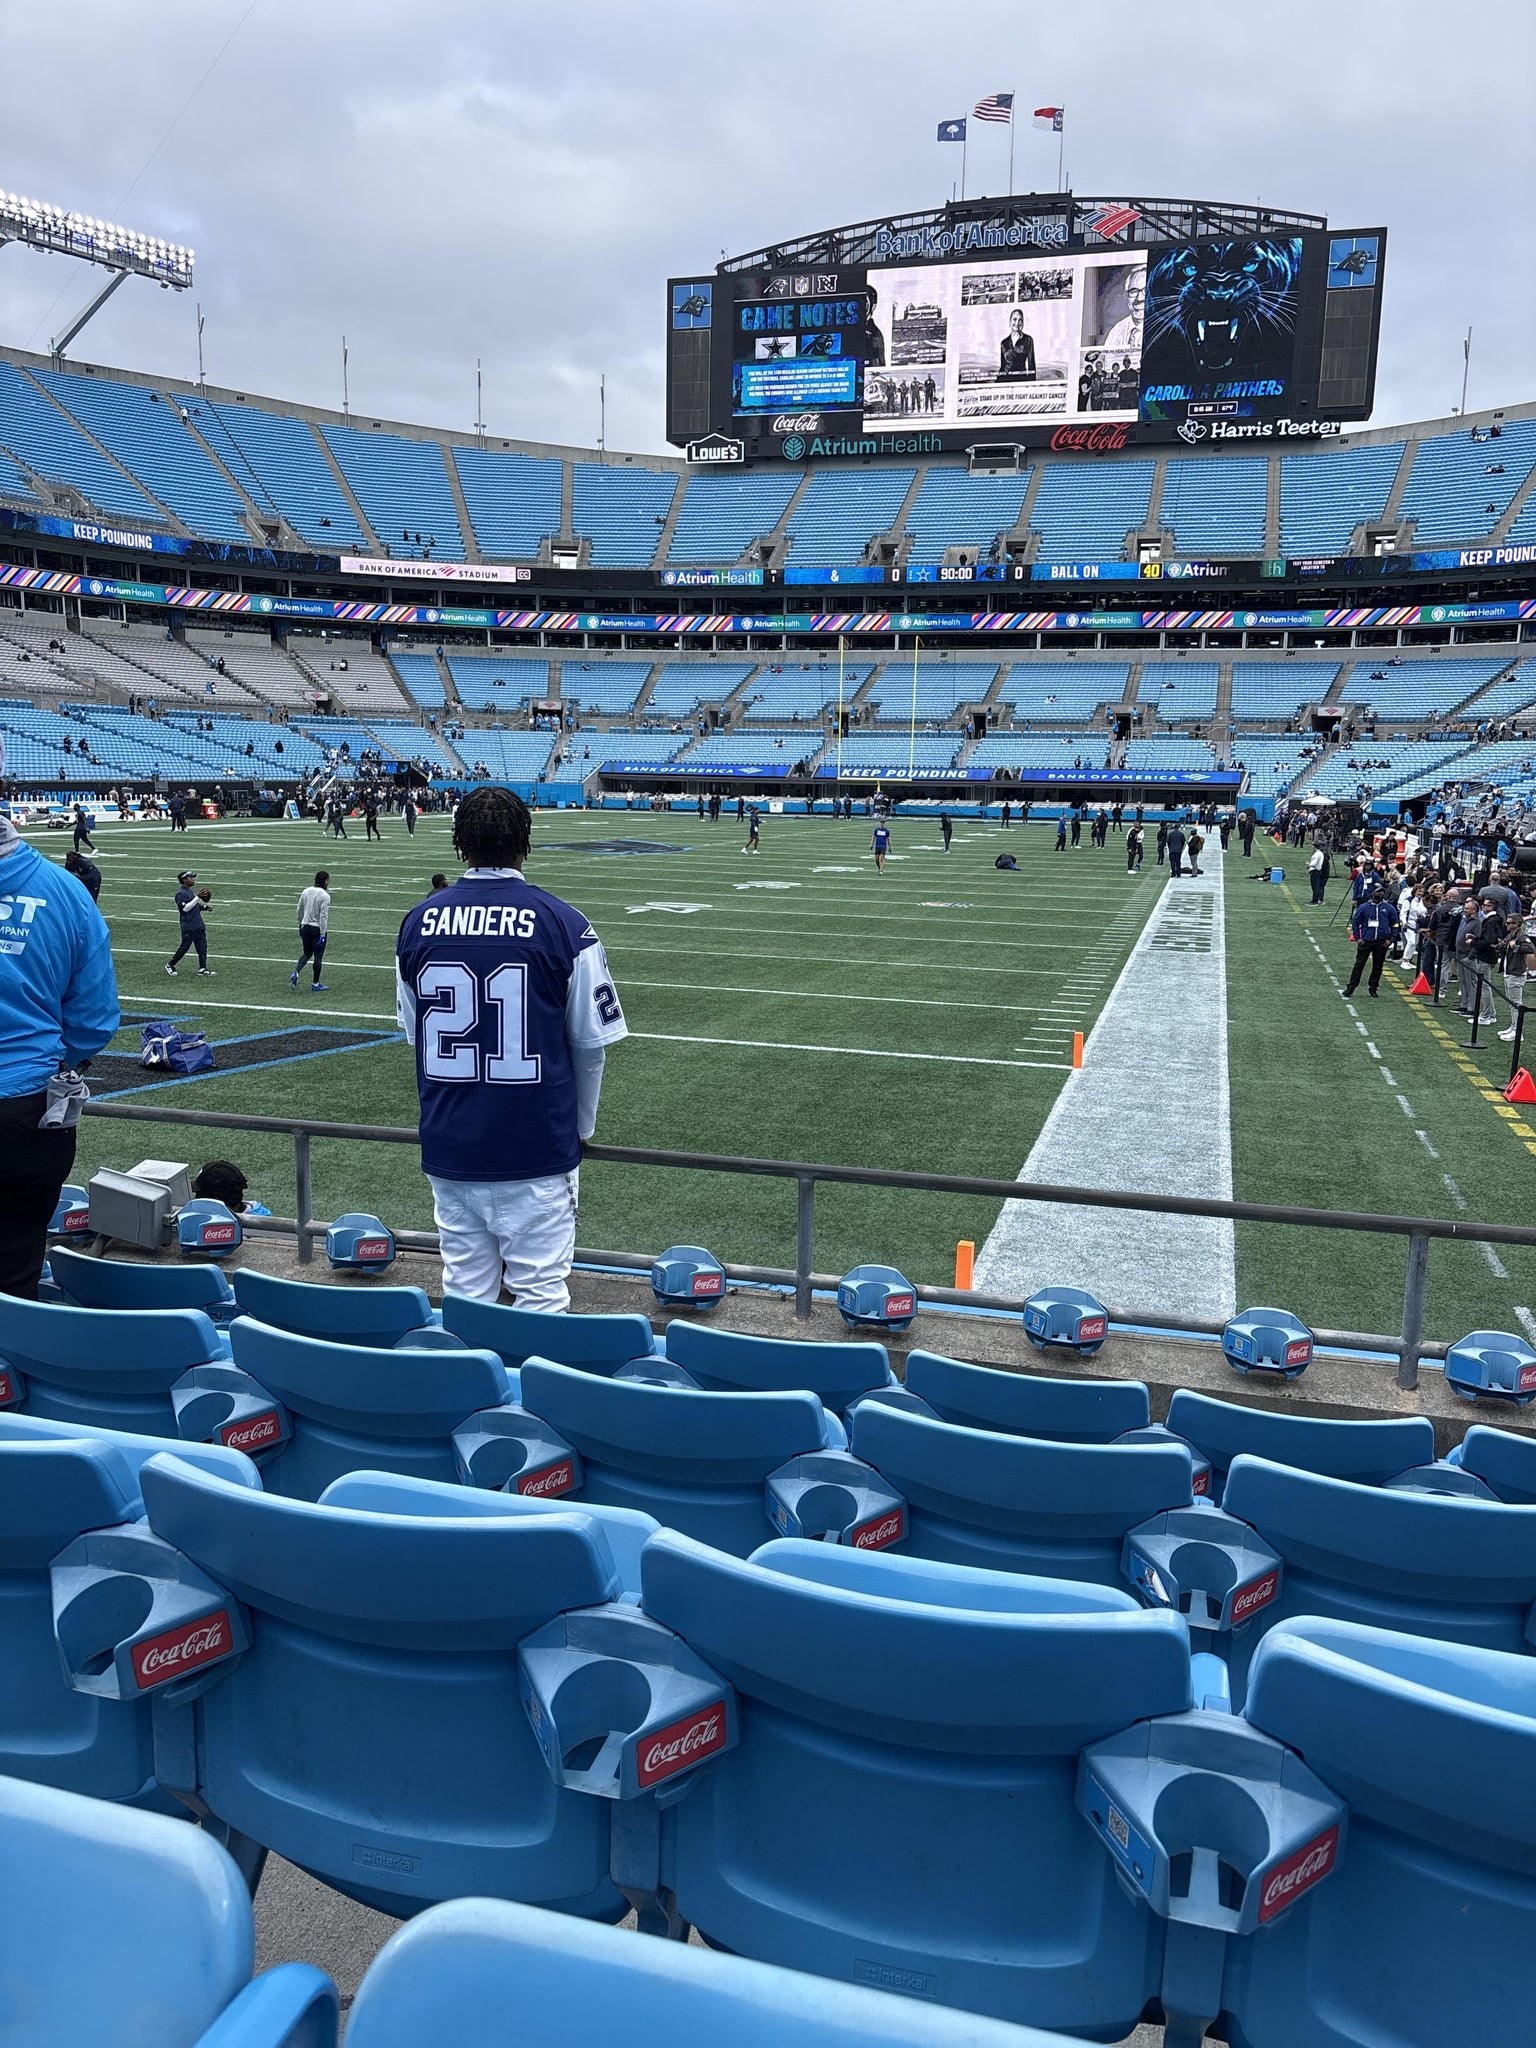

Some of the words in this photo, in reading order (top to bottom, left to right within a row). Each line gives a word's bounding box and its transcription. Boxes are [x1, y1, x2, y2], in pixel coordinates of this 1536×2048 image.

[875, 227, 936, 256] Bank
[938, 222, 964, 251] of
[965, 218, 1069, 250] America
[741, 305, 795, 331] GAME
[800, 301, 859, 327] NOTES
[1144, 384, 1211, 402] CAROLIA
[1213, 379, 1286, 398] PANTHERS
[1210, 421, 1273, 439] Harris
[1276, 419, 1341, 436] Teeter
[1050, 423, 1131, 451] Coca-Cola
[809, 437, 877, 456] Atrium
[880, 434, 942, 453] Health
[691, 445, 739, 461] LOWE'S
[73, 523, 99, 541] KEEP
[100, 528, 153, 549] POUNDING
[1459, 549, 1493, 566] KEEP
[359, 564, 383, 574] BANK
[385, 566, 396, 574] OF
[397, 567, 437, 577] AMERICA
[458, 570, 498, 580] STADIUM
[676, 571, 720, 584] Atrium
[720, 570, 760, 584] Health
[830, 569, 839, 582] &
[892, 568, 900, 582] 0
[940, 567, 972, 580] 90:00
[1014, 566, 1023, 580] 0
[1051, 565, 1079, 579] BALL
[1083, 565, 1099, 578] ON
[1142, 564, 1160, 577] 40
[105, 585, 132, 595] Atrium
[132, 586, 155, 598] Health
[274, 601, 299, 612] Atrium
[300, 603, 323, 614] Health
[1447, 609, 1477, 618] Atrium
[1478, 608, 1506, 617] Health
[440, 612, 465, 622] Atrium
[465, 613, 487, 623] Health
[600, 617, 625, 627] Atrium
[624, 618, 646, 628] Health
[754, 620, 783, 628] Atrium
[783, 619, 800, 628] Health
[913, 618, 938, 626] Atrium
[938, 618, 961, 627] Health
[1080, 615, 1107, 624] Atrium
[1107, 615, 1131, 625] Health
[1258, 615, 1287, 624] Atrium
[1287, 615, 1312, 624] Health
[623, 766, 660, 774] BANK
[662, 766, 680, 774] OF
[683, 767, 734, 775] AMERICA
[840, 768, 882, 778] KEEP
[885, 769, 967, 779] POUNDING
[420, 905, 537, 938] SANDERS
[593, 982, 622, 1026] 2
[416, 960, 542, 1084] 21
[65, 1214, 89, 1227] Coca-Co
